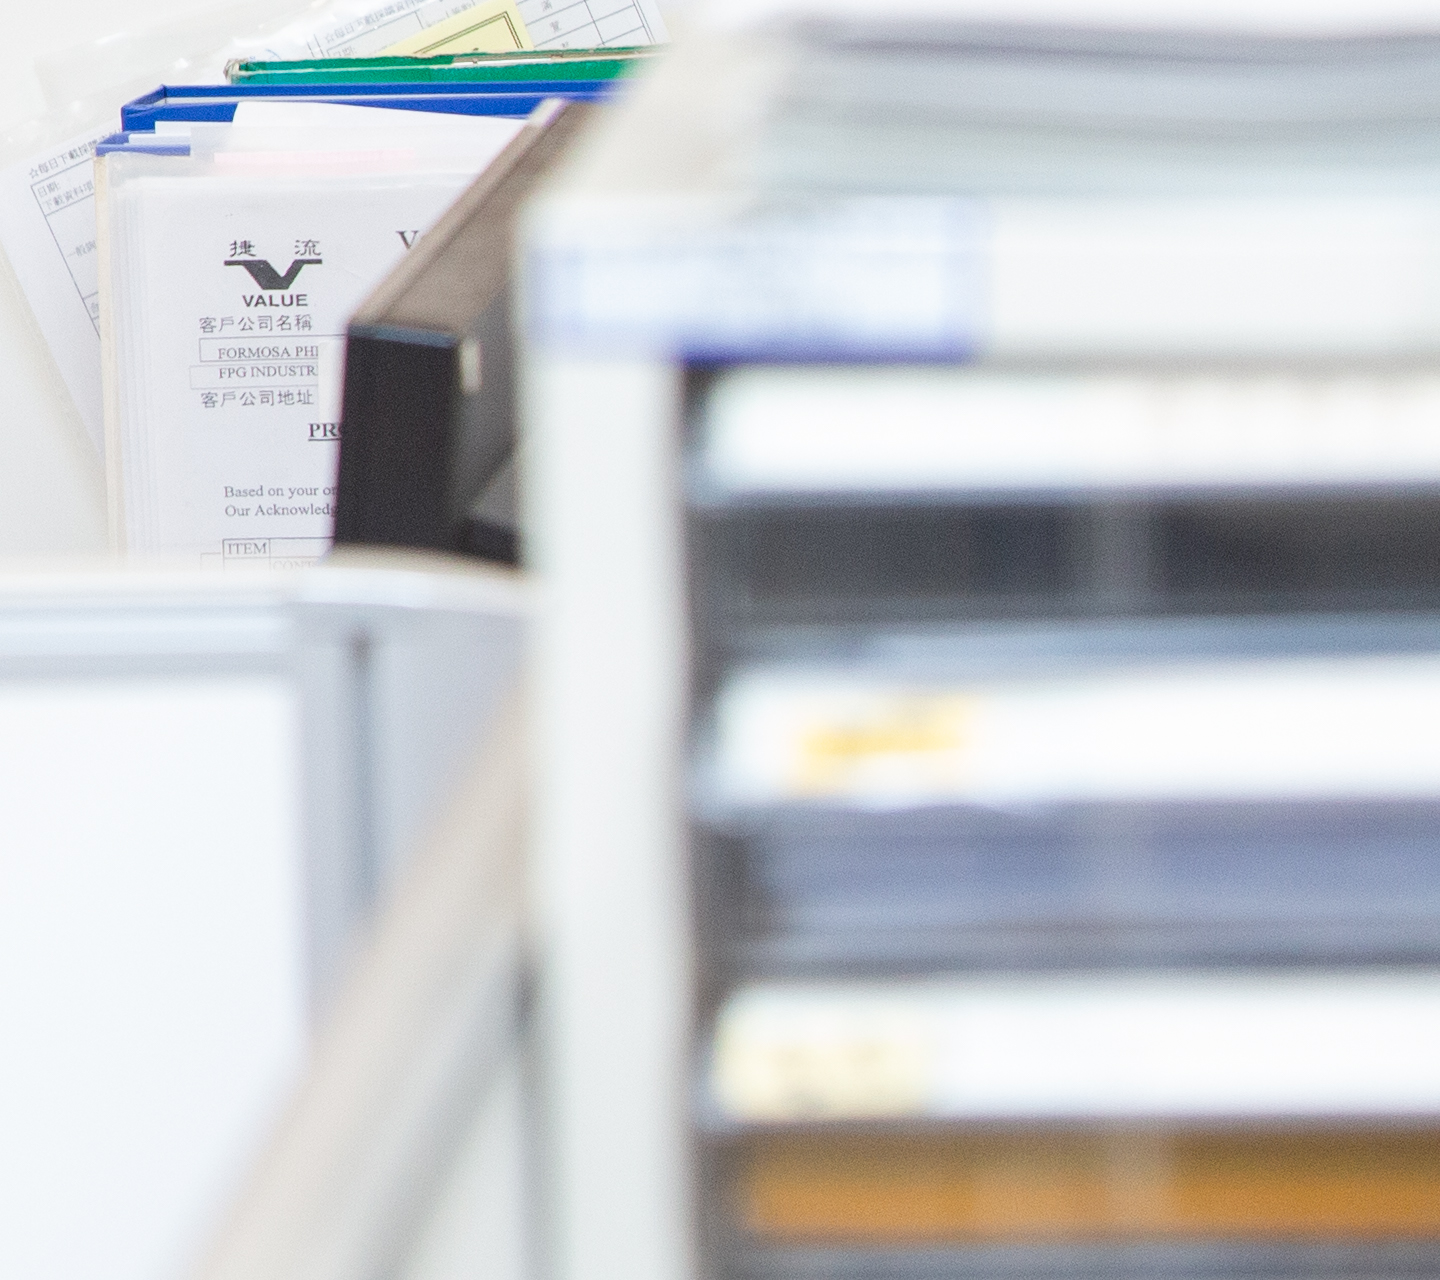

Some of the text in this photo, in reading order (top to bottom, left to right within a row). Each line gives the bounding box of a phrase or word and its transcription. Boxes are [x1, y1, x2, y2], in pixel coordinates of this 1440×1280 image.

[242, 294, 308, 307] VALUE
[218, 346, 291, 360] FORMOSA
[219, 367, 246, 379] FPG
[308, 422, 340, 438] PR
[224, 485, 264, 498] Based
[268, 488, 284, 497] on
[288, 487, 319, 499] your
[225, 505, 250, 517] Our
[228, 542, 267, 555] ITEM
